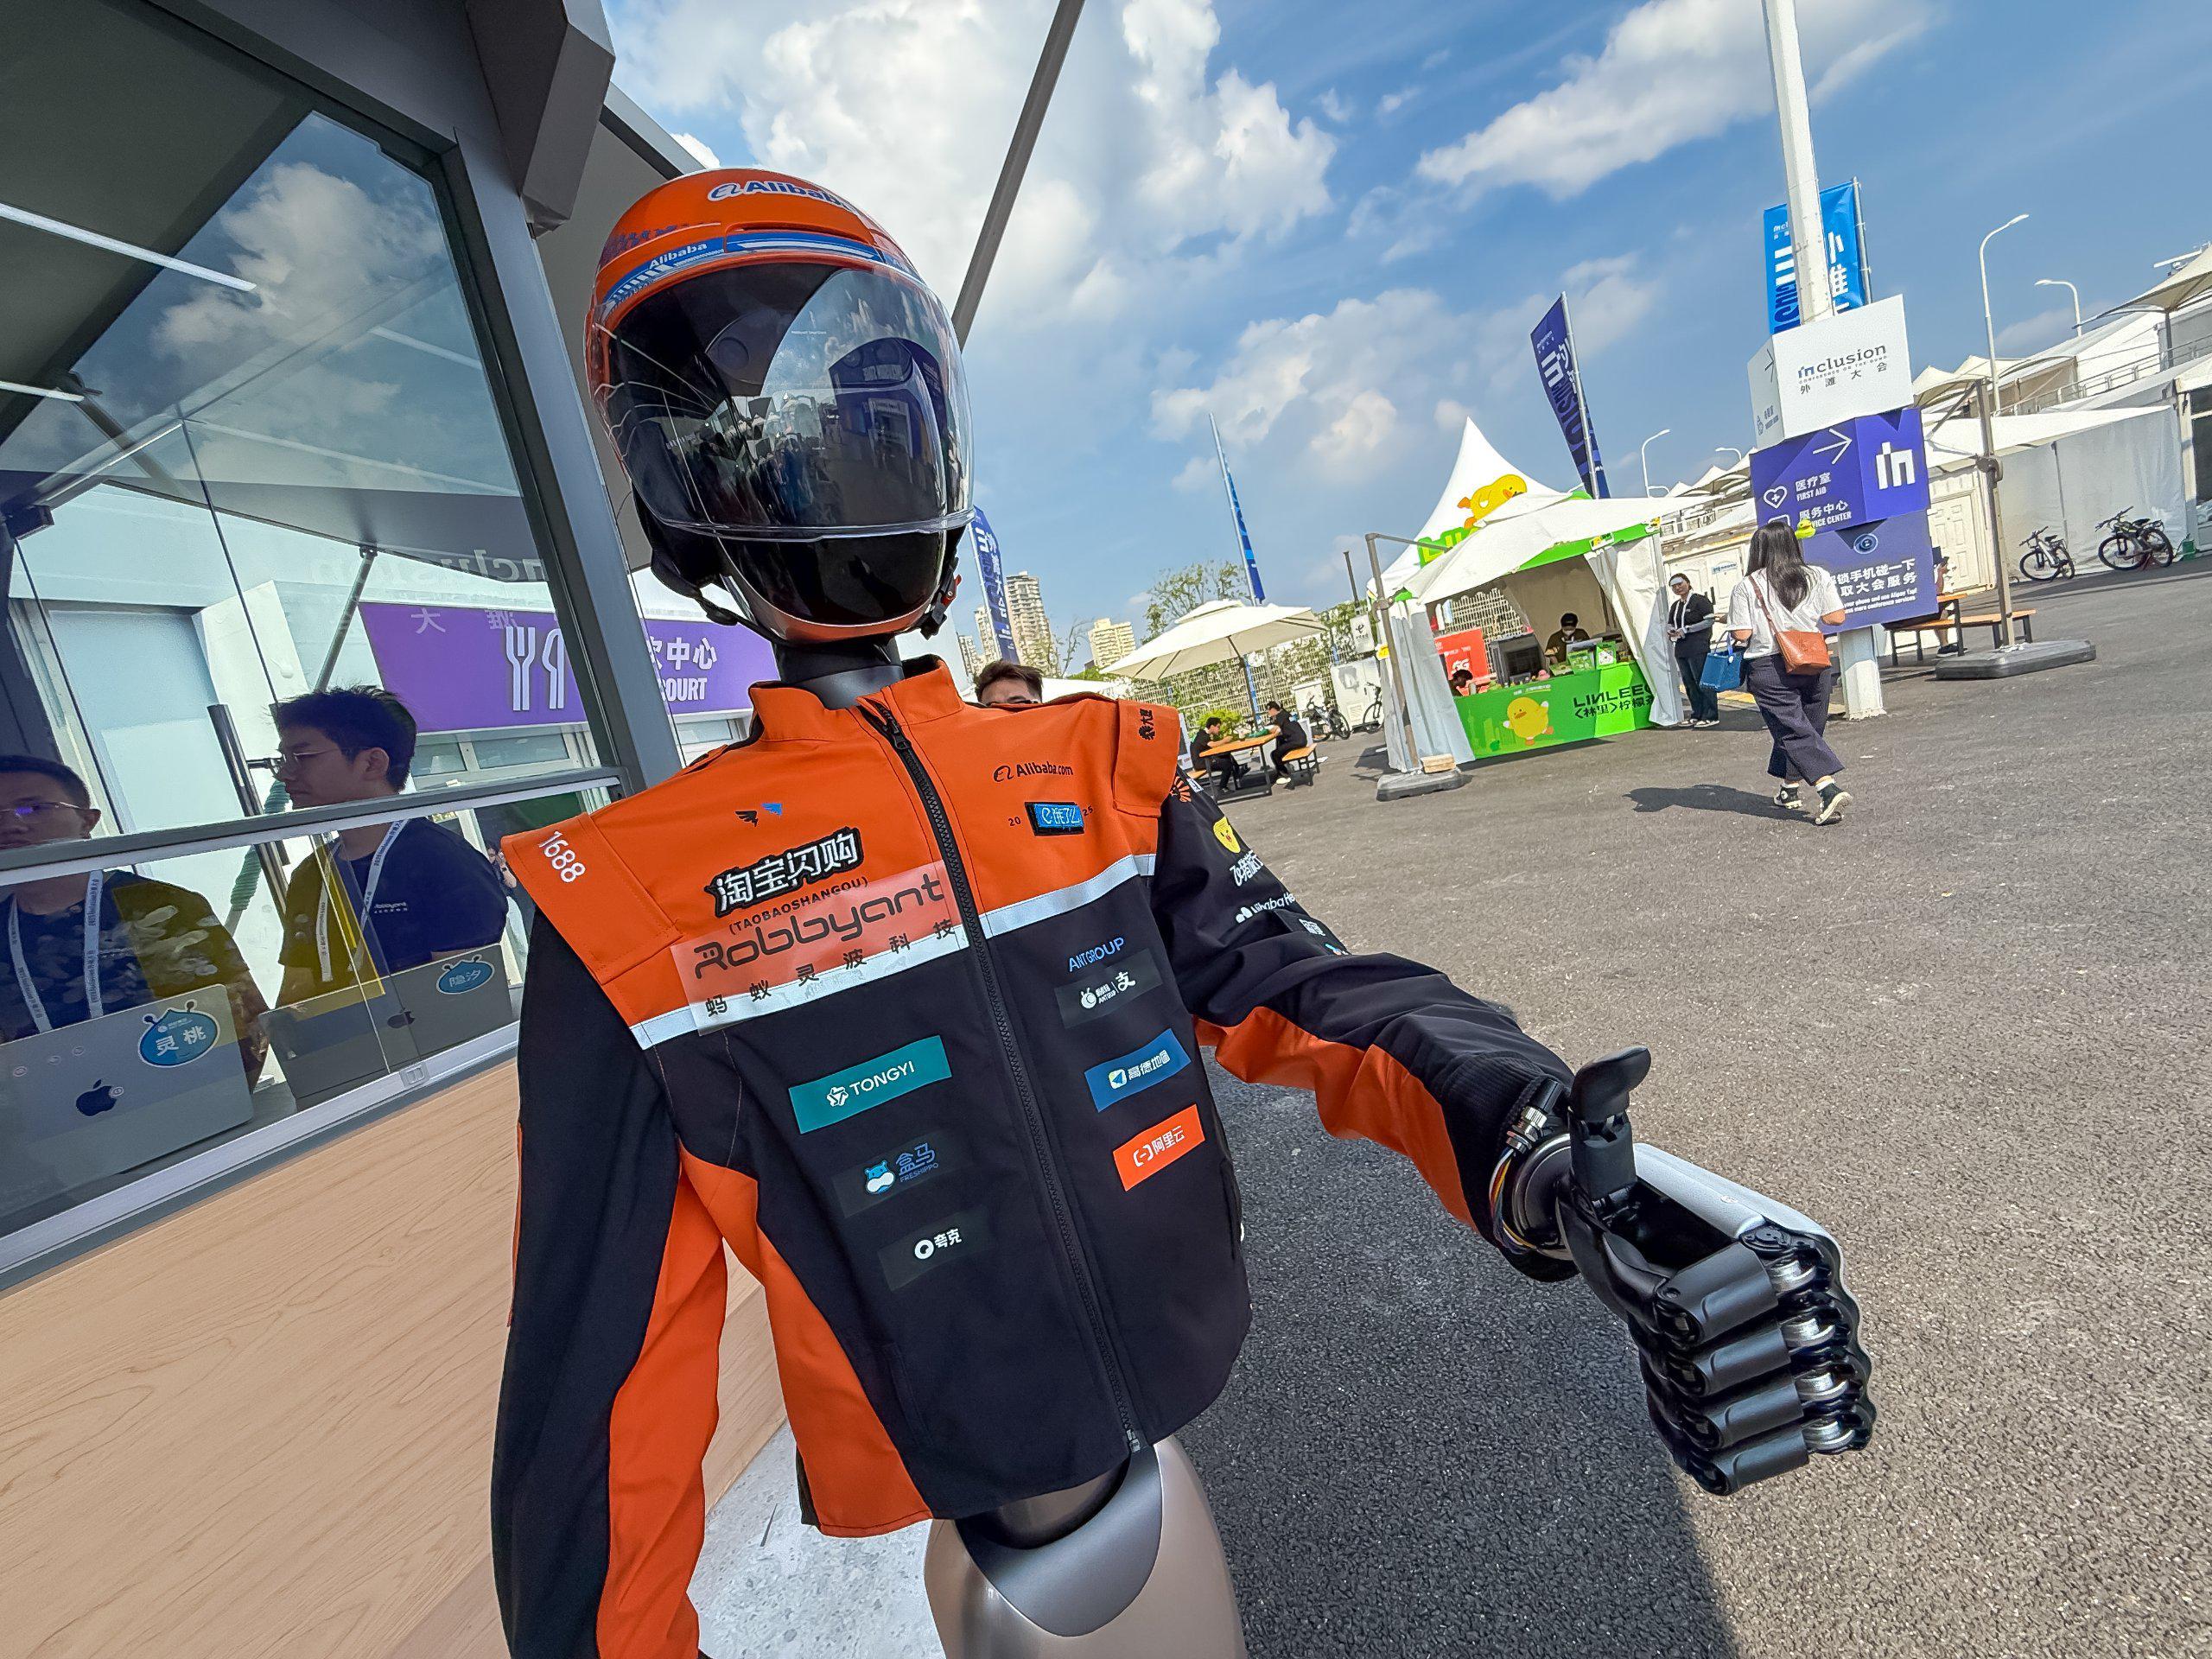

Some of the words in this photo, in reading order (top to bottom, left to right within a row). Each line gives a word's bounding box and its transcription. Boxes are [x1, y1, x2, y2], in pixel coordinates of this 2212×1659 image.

[747, 181, 850, 209] Alibab
[650, 243, 708, 270] Alibaba
[1798, 346, 1886, 378] inclusion
[1801, 362, 1888, 395] 外滩大会
[1795, 472, 1832, 493] 医疗室
[1796, 490, 1815, 502] FIRST
[1815, 486, 1827, 498] AID
[1800, 499, 1849, 520] 服务中心
[1812, 516, 1827, 529] VICE
[1827, 512, 1852, 524] CENTER
[1840, 572, 1917, 597] 取大会服务
[1016, 761, 1073, 777] Alibaba.com
[1007, 817, 1021, 826] 20
[1083, 805, 1093, 817] 25
[538, 831, 586, 883] 1688
[716, 832, 858, 912] 淘宝闪购
[728, 876, 868, 936] (TAOBAOSHANGOU)
[694, 873, 944, 979] Robbyant
[705, 918, 956, 1017] 蚂蚁灵波科技
[156, 1026, 207, 1056] 灵桃
[849, 1060, 915, 1096] TONGYI
[1128, 1049, 1171, 1080] 高德地图
[1152, 1125, 1185, 1154] 阿里云
[895, 1142, 936, 1176] 盒马
[899, 1162, 939, 1182] FRESHIPPO
[933, 1228, 963, 1248] 夸克
